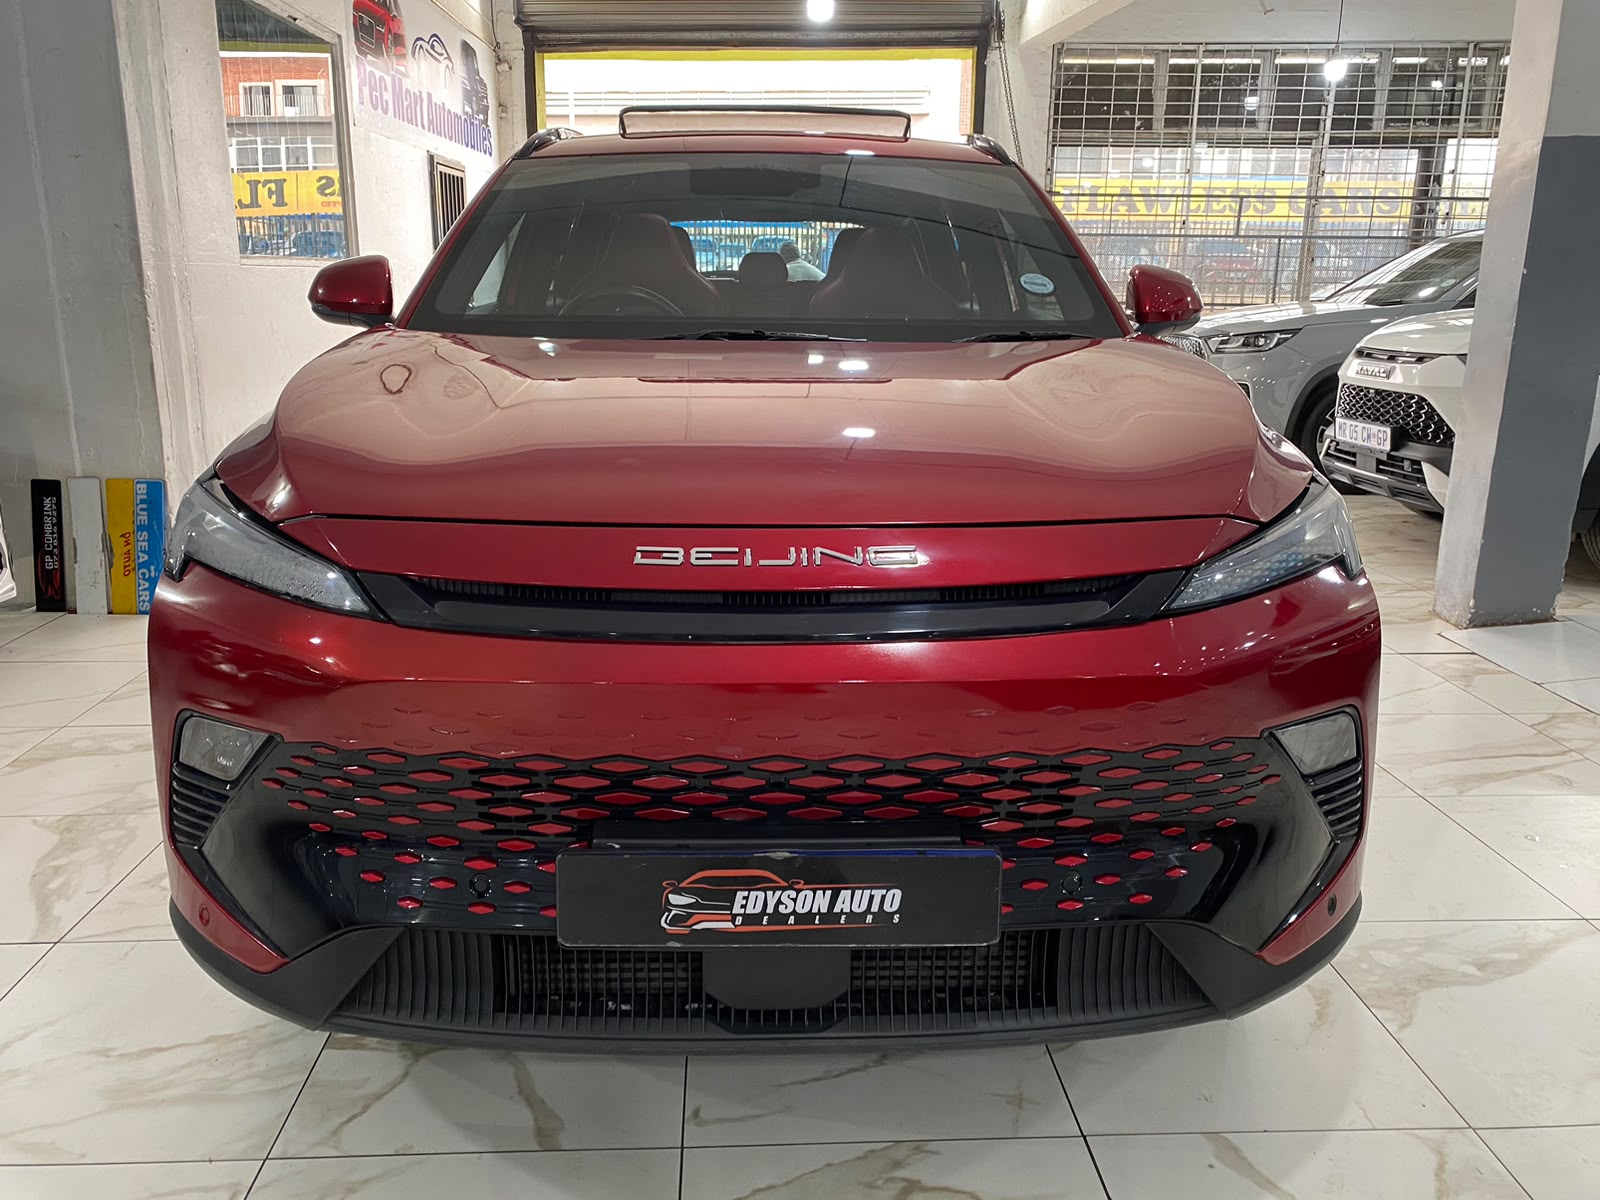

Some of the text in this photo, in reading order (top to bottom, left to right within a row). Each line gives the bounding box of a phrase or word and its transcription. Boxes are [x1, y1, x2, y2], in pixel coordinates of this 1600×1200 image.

[390, 72, 426, 130] Mart
[426, 91, 493, 157] Automobiles
[1058, 185, 1401, 215] FLAWLESS CARS
[1338, 420, 1346, 439] MR
[1377, 429, 1388, 447] GP
[43, 496, 54, 569] GP COMBRINK
[136, 483, 151, 611] BLUE SEA CARS
[633, 545, 920, 567] BEIJING
[731, 889, 902, 914] EDYSON AUTO
[735, 914, 900, 925] DEALERS
